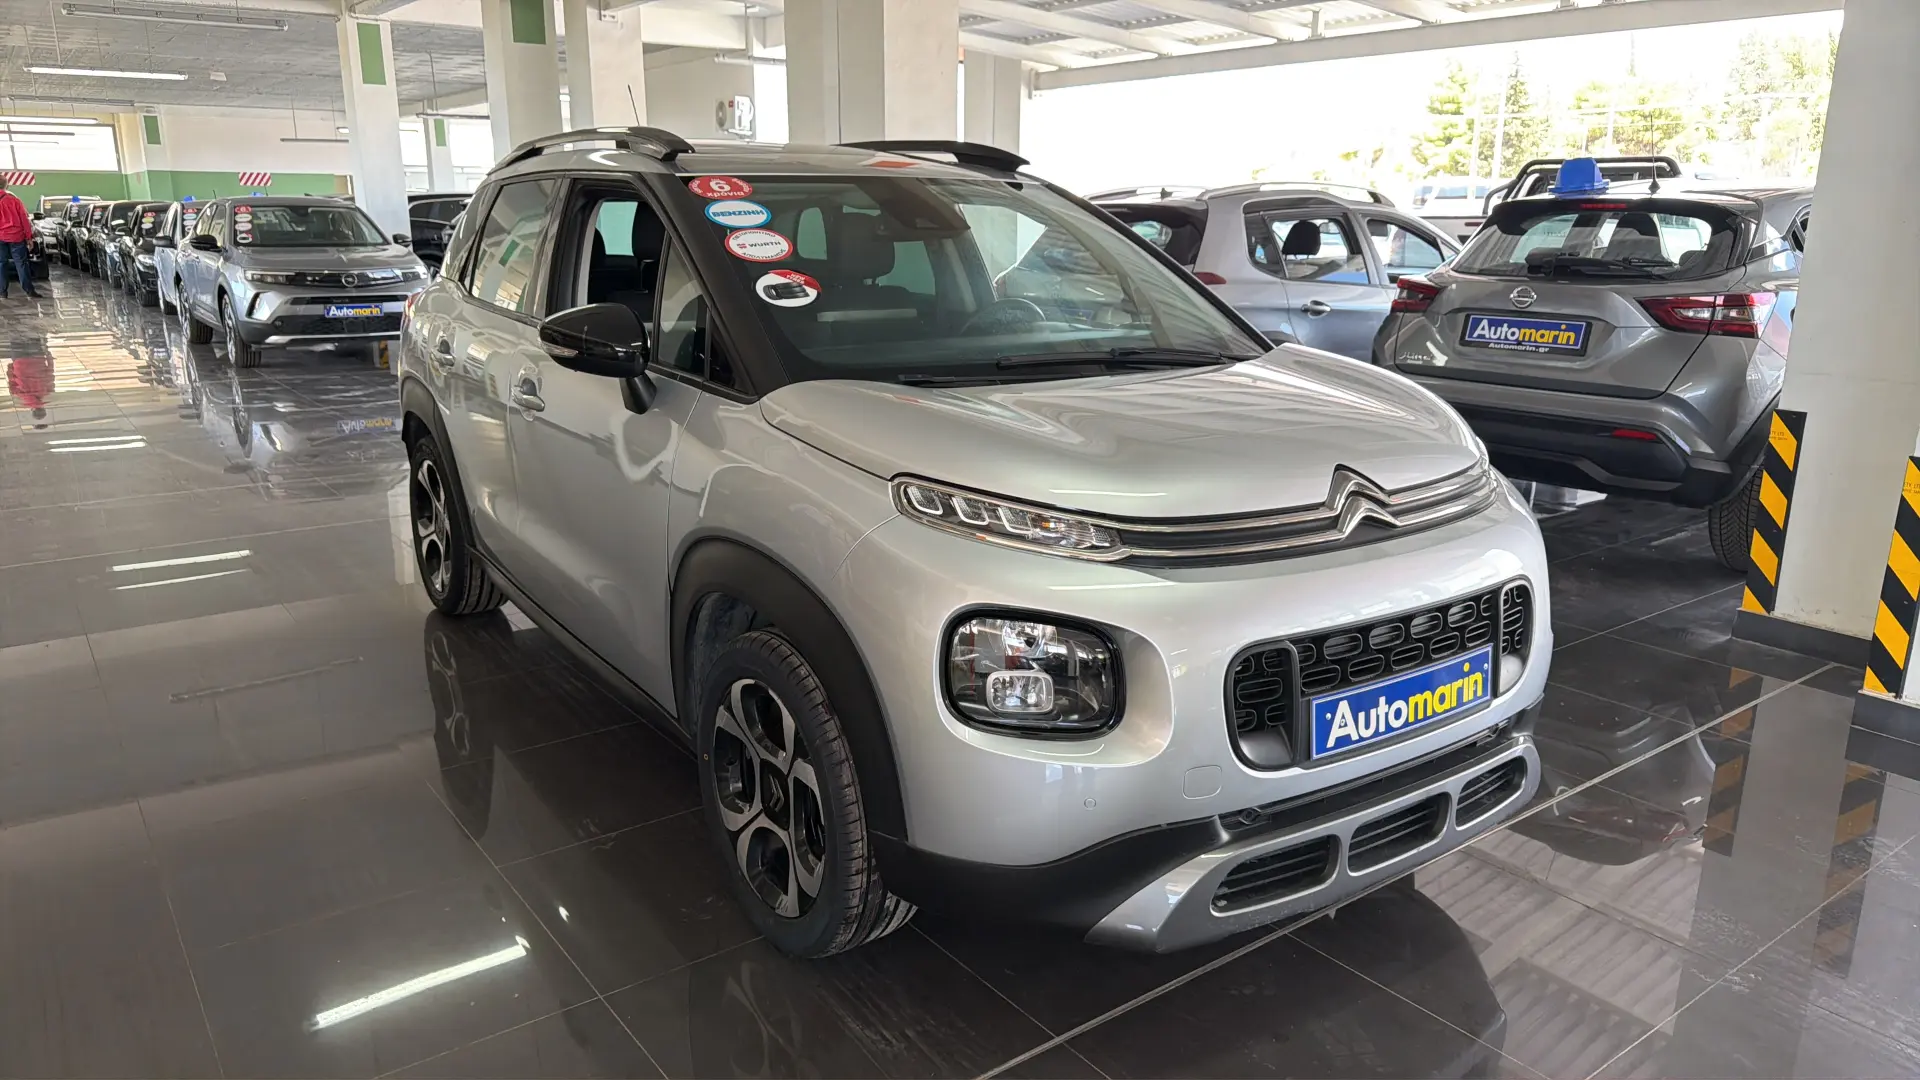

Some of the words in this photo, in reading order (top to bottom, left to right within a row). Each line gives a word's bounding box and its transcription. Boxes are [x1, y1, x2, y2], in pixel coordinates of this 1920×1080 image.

[709, 179, 731, 192] 6
[329, 305, 381, 317] Automarin
[1472, 318, 1576, 346] Automarin
[1488, 342, 1550, 353] Automarin.gr
[1326, 662, 1483, 749] Automarin
